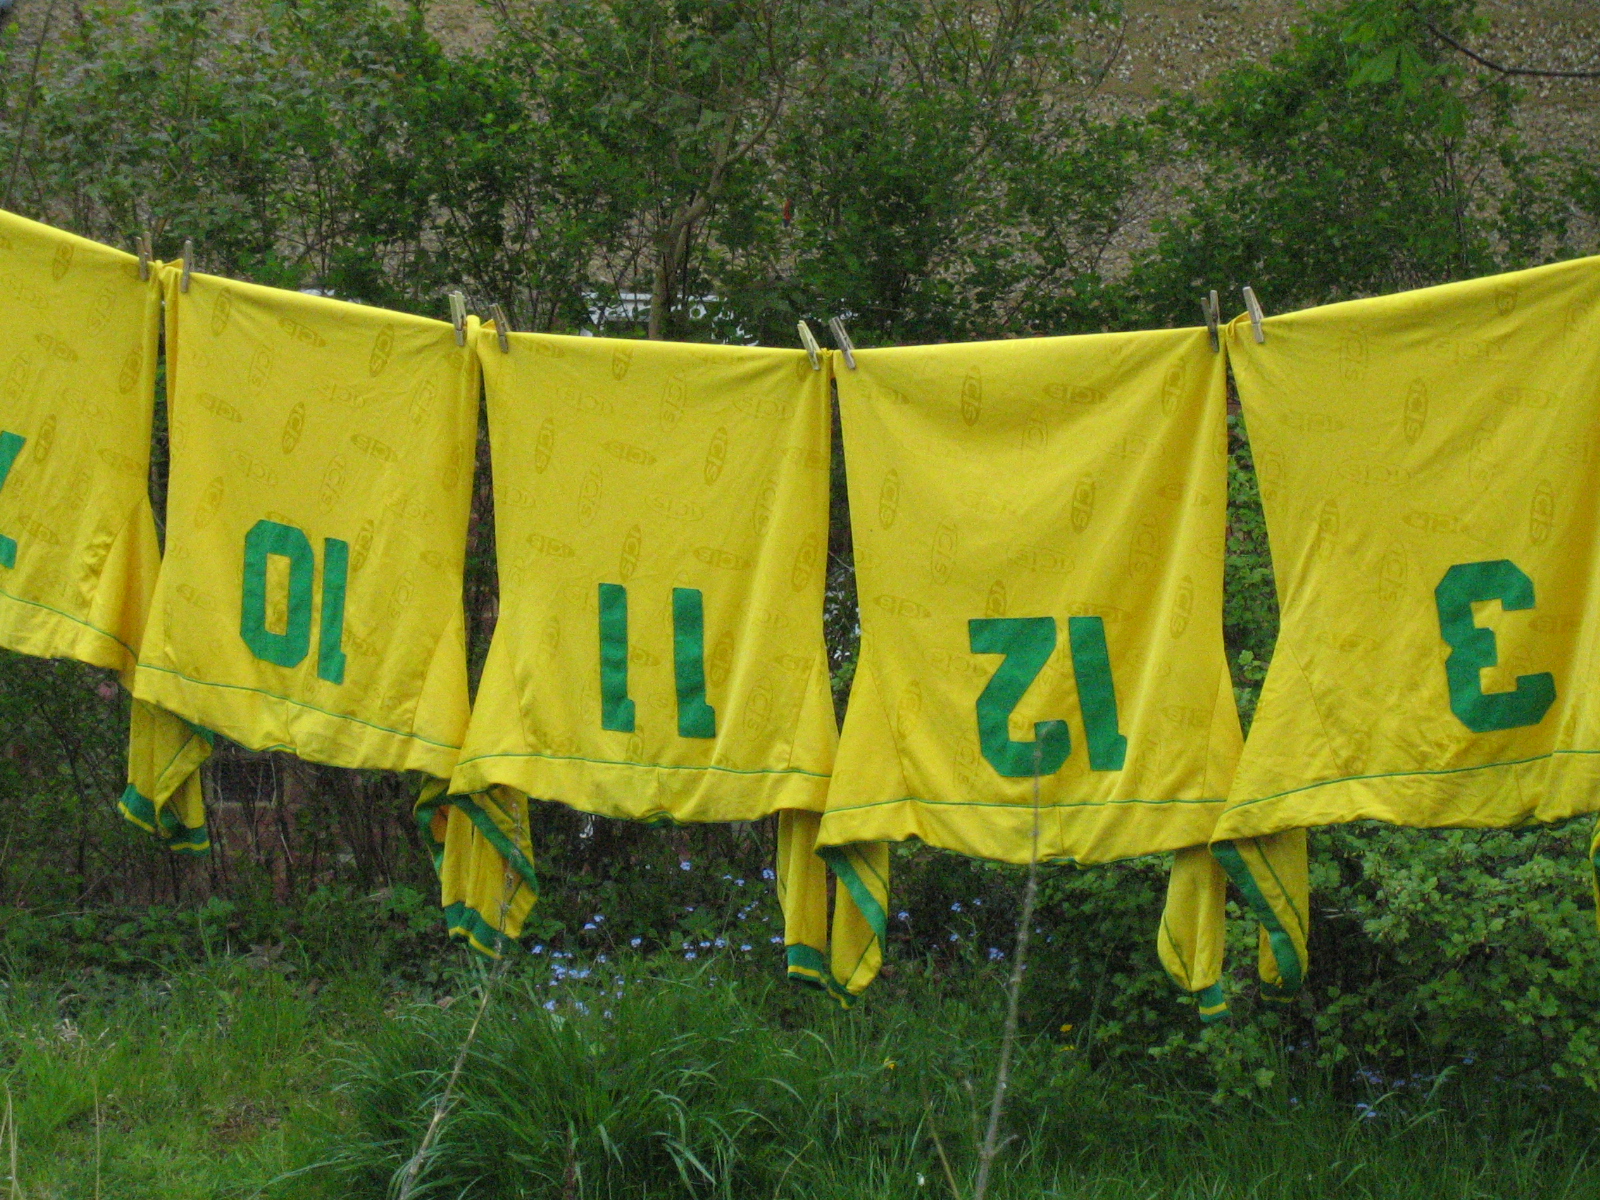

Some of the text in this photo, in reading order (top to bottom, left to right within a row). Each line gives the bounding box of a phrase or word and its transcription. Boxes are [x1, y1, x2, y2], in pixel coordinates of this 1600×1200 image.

[240, 519, 349, 685] 10
[598, 582, 717, 740] 11
[1434, 559, 1557, 733] 3
[968, 616, 1128, 777] 12
